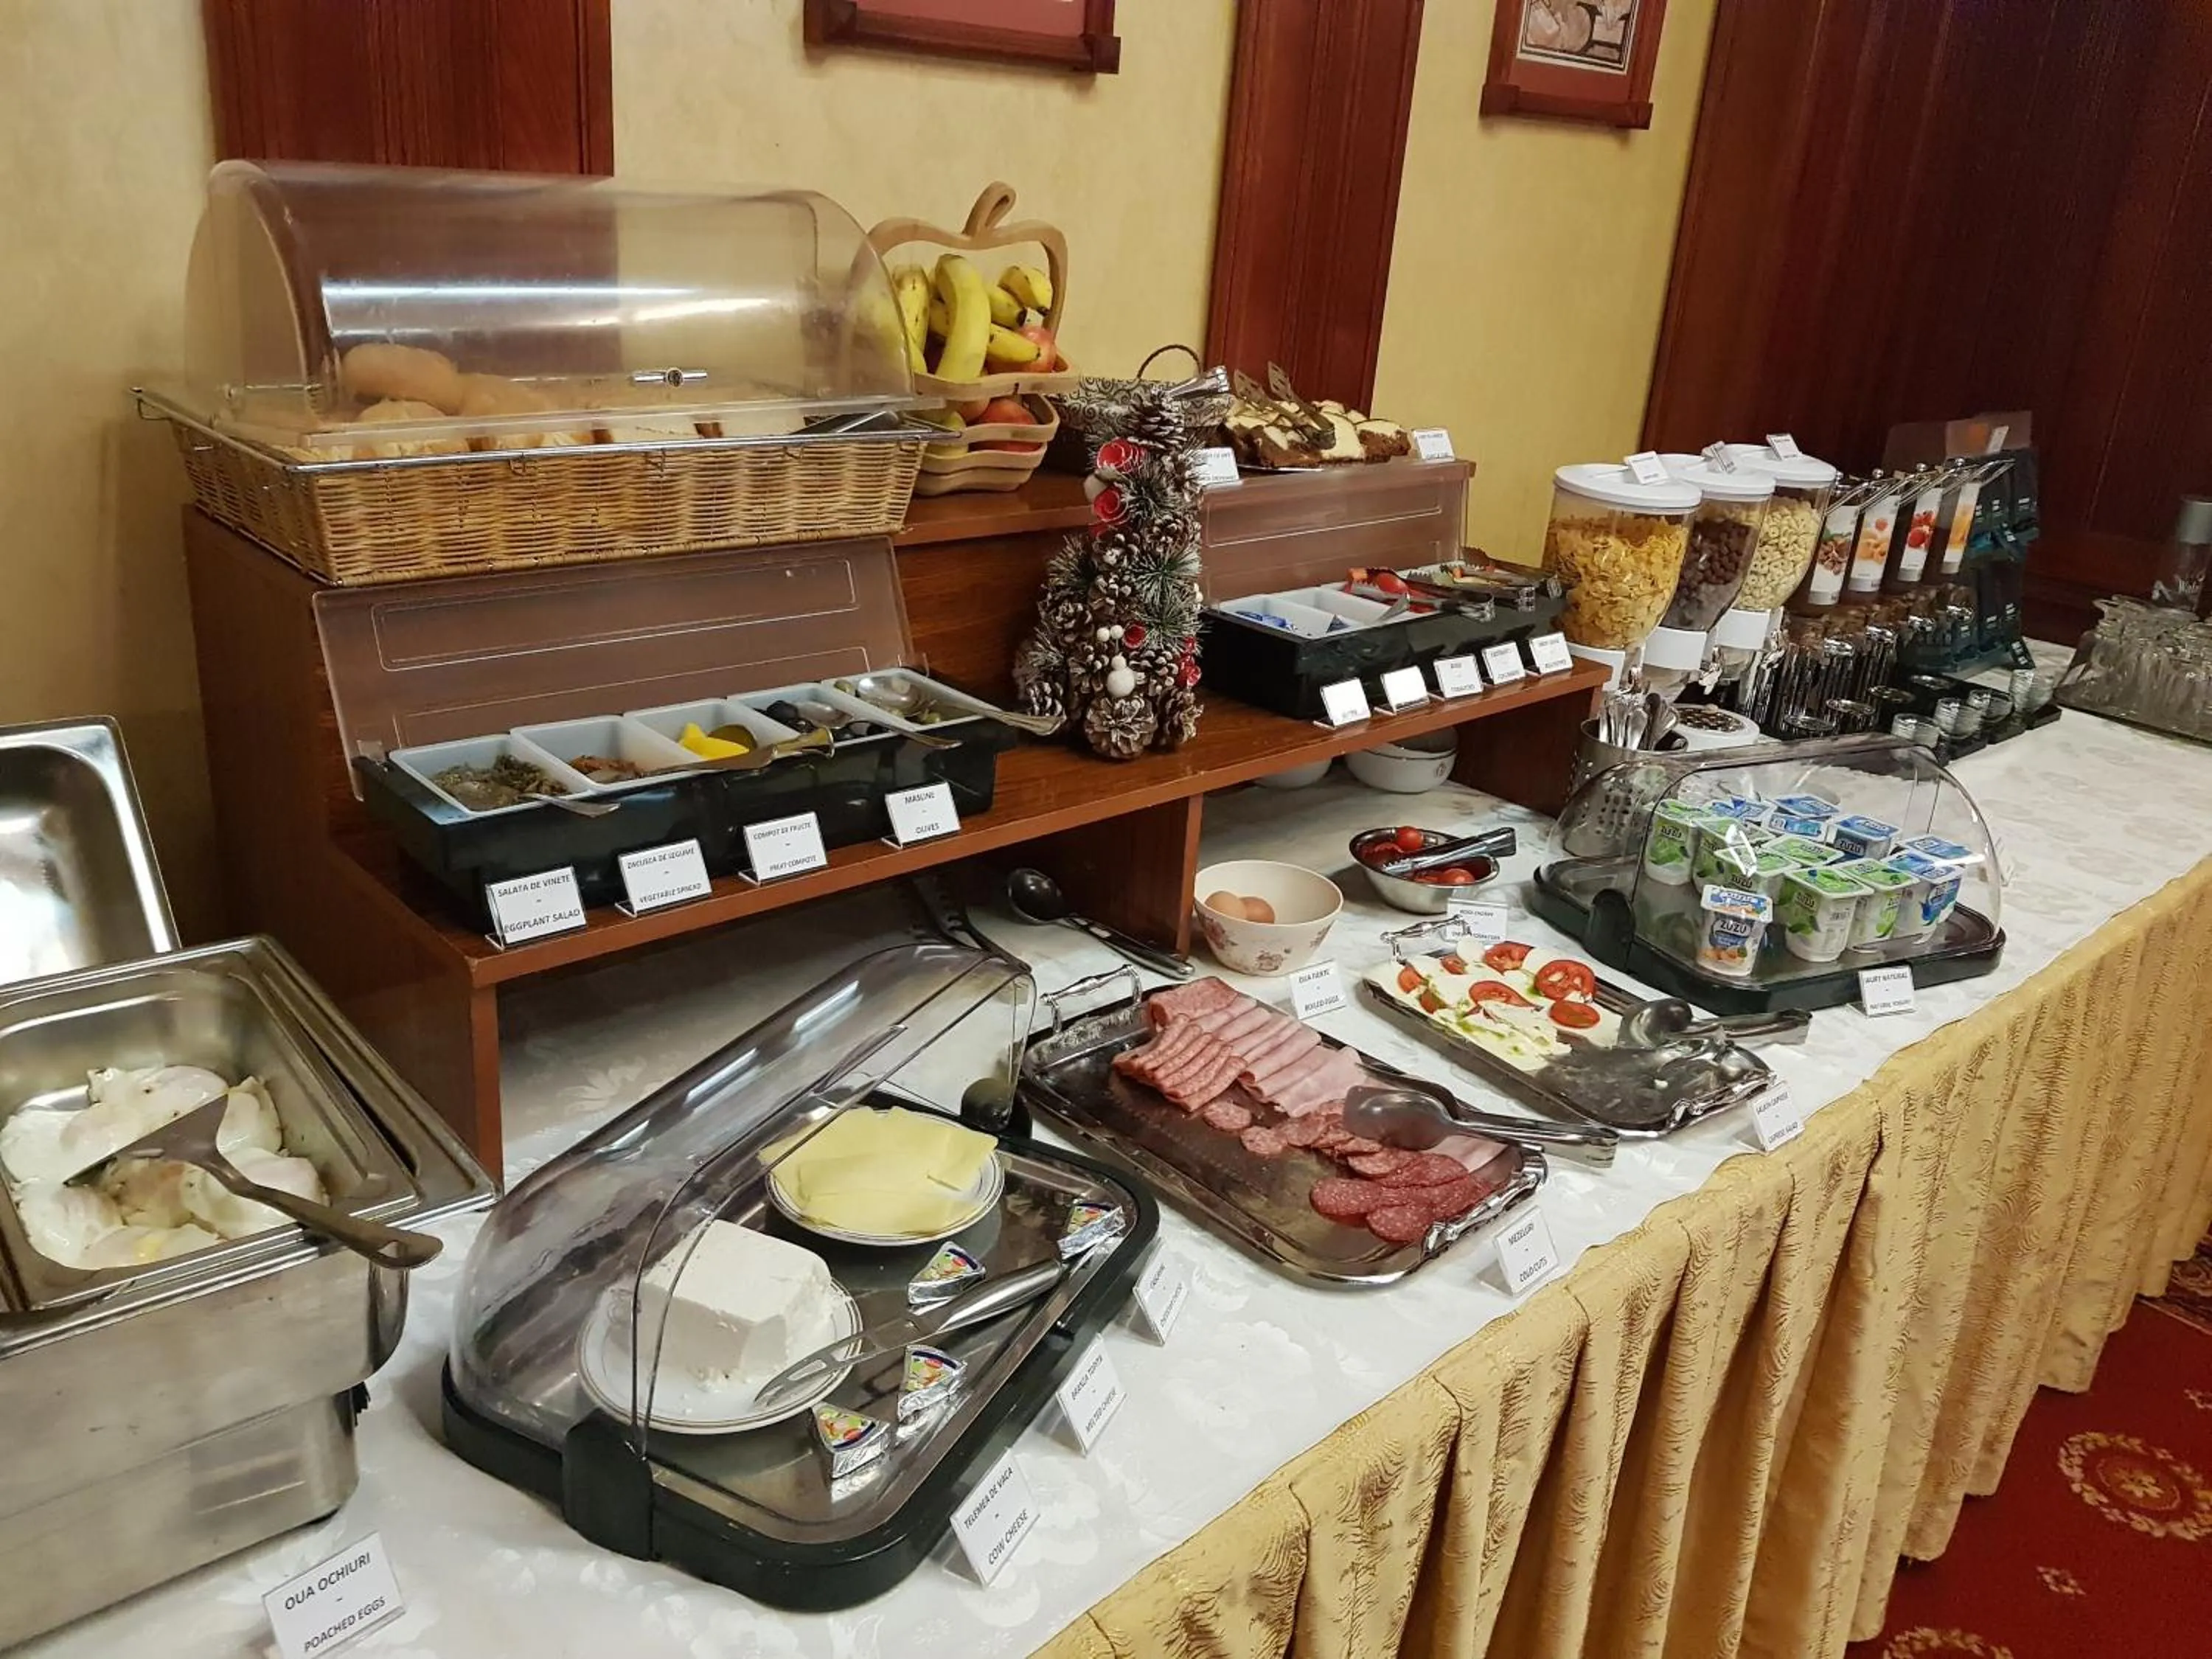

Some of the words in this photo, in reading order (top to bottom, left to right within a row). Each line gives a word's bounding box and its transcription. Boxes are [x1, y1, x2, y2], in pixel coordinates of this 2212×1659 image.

[915, 822, 939, 834] OLIVES
[498, 884, 529, 897] SALATA
[530, 881, 541, 890] DE
[543, 874, 570, 886] VINETE
[504, 915, 551, 933] EGGPLANT
[552, 908, 580, 922] SALAD
[1720, 919, 1747, 933] ZUZU
[963, 1494, 990, 1530] TELEMEA
[990, 1484, 998, 1499] DE
[997, 1466, 1013, 1489] VACA
[987, 1537, 1005, 1565] COW
[1005, 1507, 1029, 1544] CHEESE
[285, 1585, 316, 1610] OUA
[318, 1551, 371, 1591] OCHIURI
[304, 1614, 356, 1652] POACHED
[358, 1596, 386, 1620] EGGS
